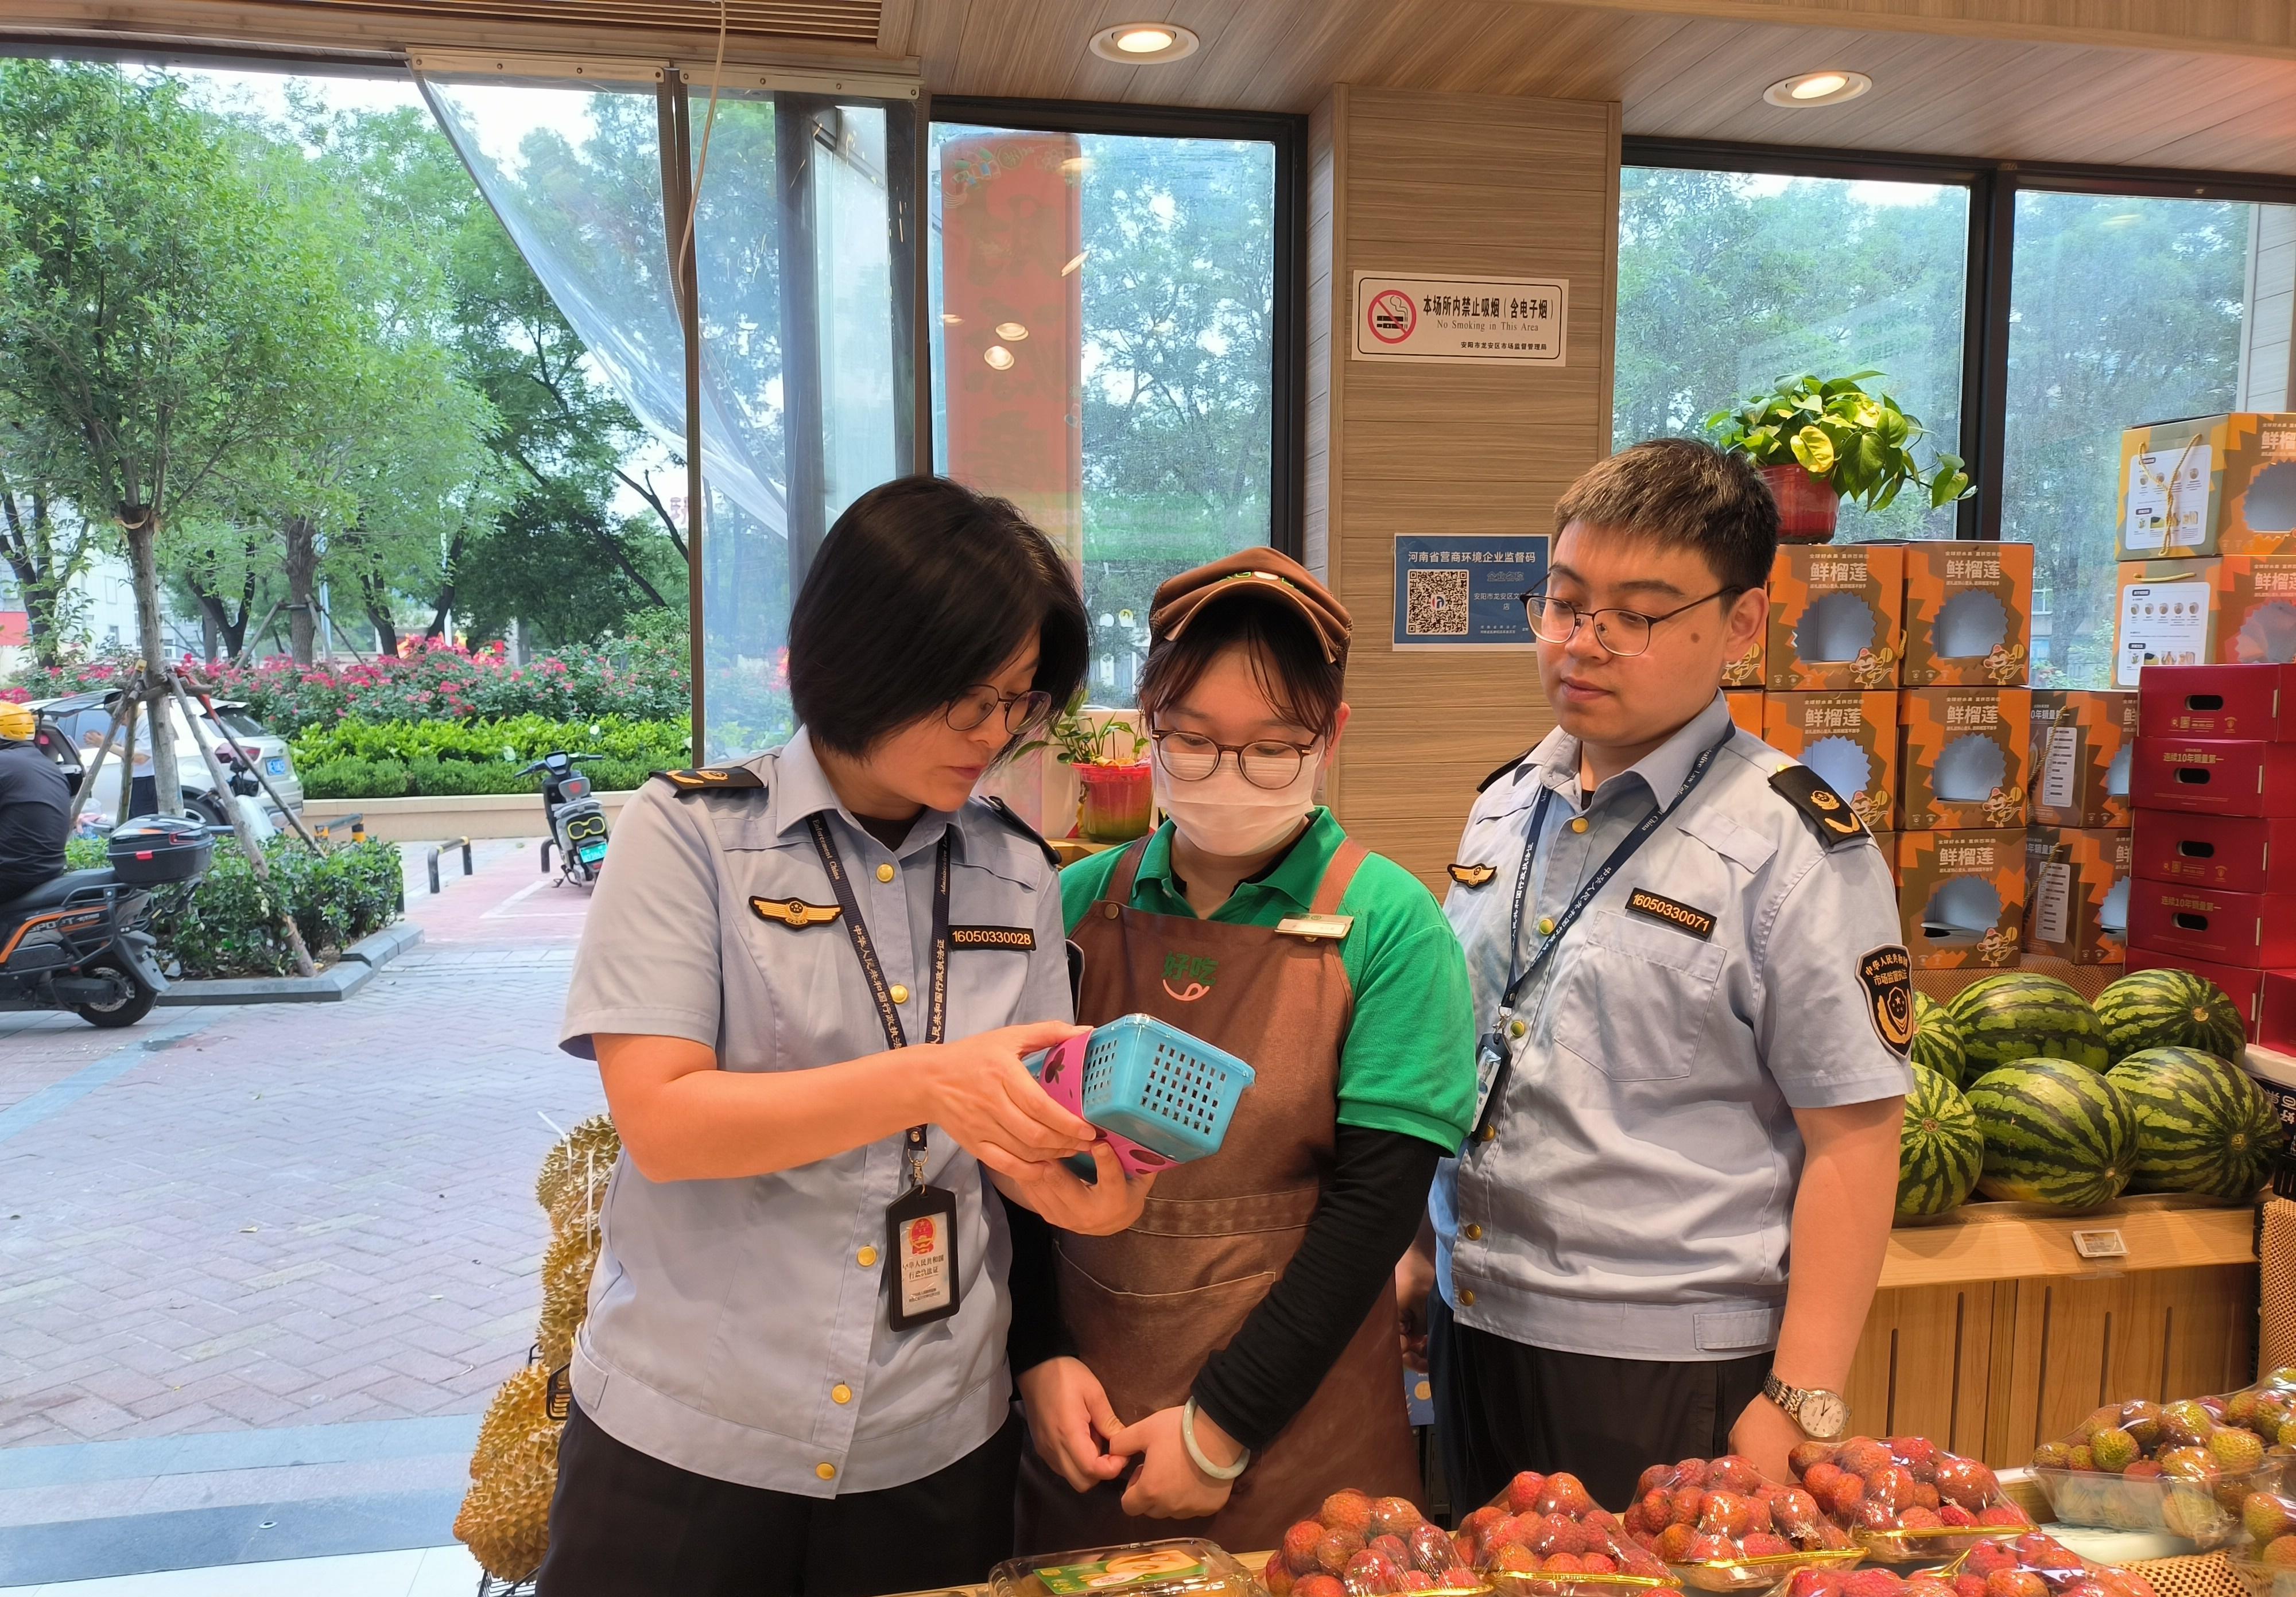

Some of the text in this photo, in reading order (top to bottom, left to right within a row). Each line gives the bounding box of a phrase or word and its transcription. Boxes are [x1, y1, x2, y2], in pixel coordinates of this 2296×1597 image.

[1437, 319, 1539, 332] No Smoking in This Area
[1460, 341, 1547, 351] 安阳市龙安区市场监督管理局
[1408, 551, 1536, 564] 河南省营商环境企业监督码
[1809, 562, 1868, 582] 鲜榴莲
[1946, 559, 2000, 579] 鲜榴莲
[1804, 708, 1862, 728] 鲜榴莲
[1946, 705, 1999, 724] 鲜榴莲
[2163, 752, 2225, 764] 连续10年销量第一
[1688, 770, 1700, 783] Law
[1641, 815, 1658, 831] China
[812, 819, 840, 880] Enforcement China
[1939, 847, 1994, 866] 鲜榴莲
[1632, 893, 1710, 932] 16050330071
[2161, 895, 2222, 912] 连续10年销量第一
[952, 930, 1032, 946] 16050330028
[1161, 950, 1219, 985] 好吃
[1865, 953, 1908, 976] 中华人民共和国
